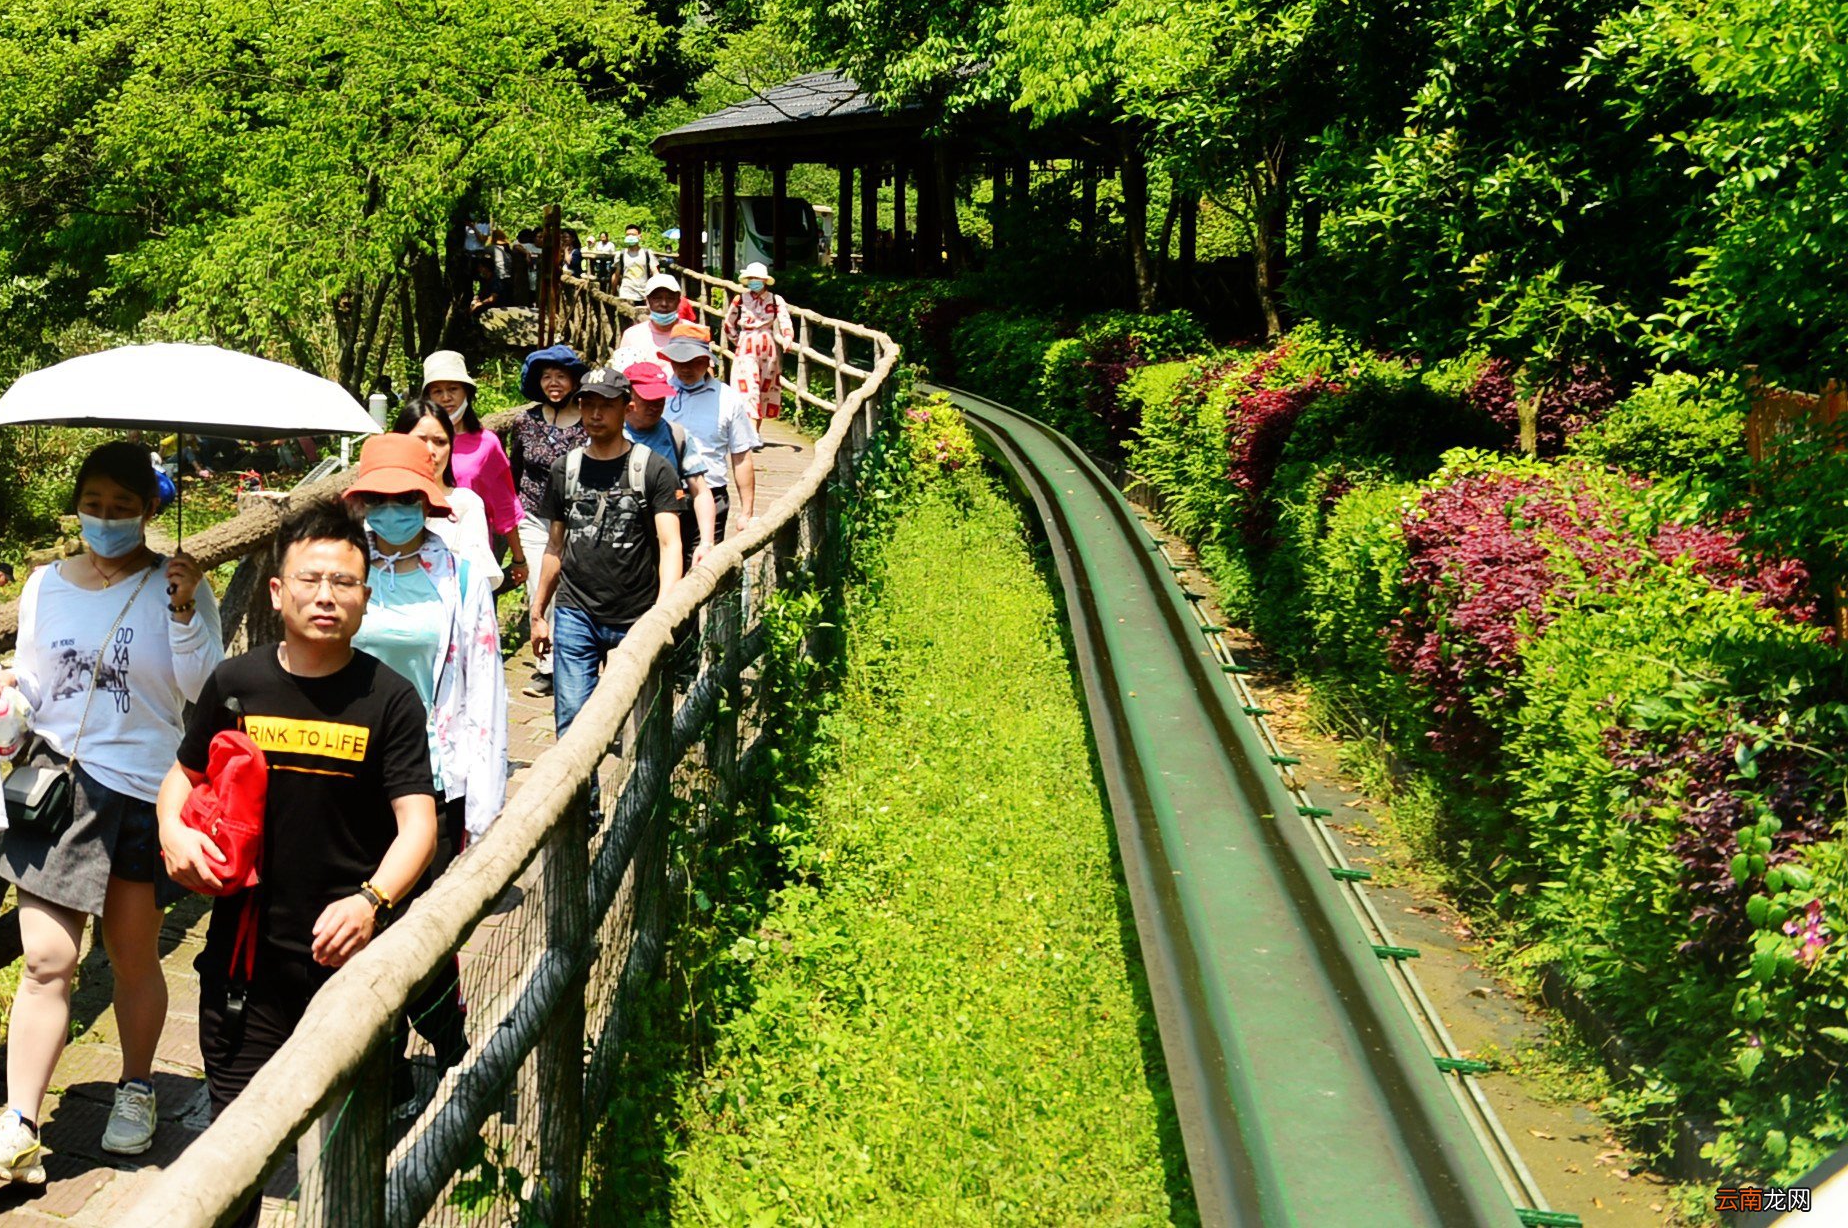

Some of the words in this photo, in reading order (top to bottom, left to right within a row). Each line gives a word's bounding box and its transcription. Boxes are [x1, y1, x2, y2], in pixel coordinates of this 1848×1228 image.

[115, 627, 134, 645] OD
[112, 644, 130, 666] XA
[113, 691, 131, 714] YO
[249, 725, 289, 744] RINK
[298, 729, 320, 746] TO
[325, 732, 365, 753] LIFE
